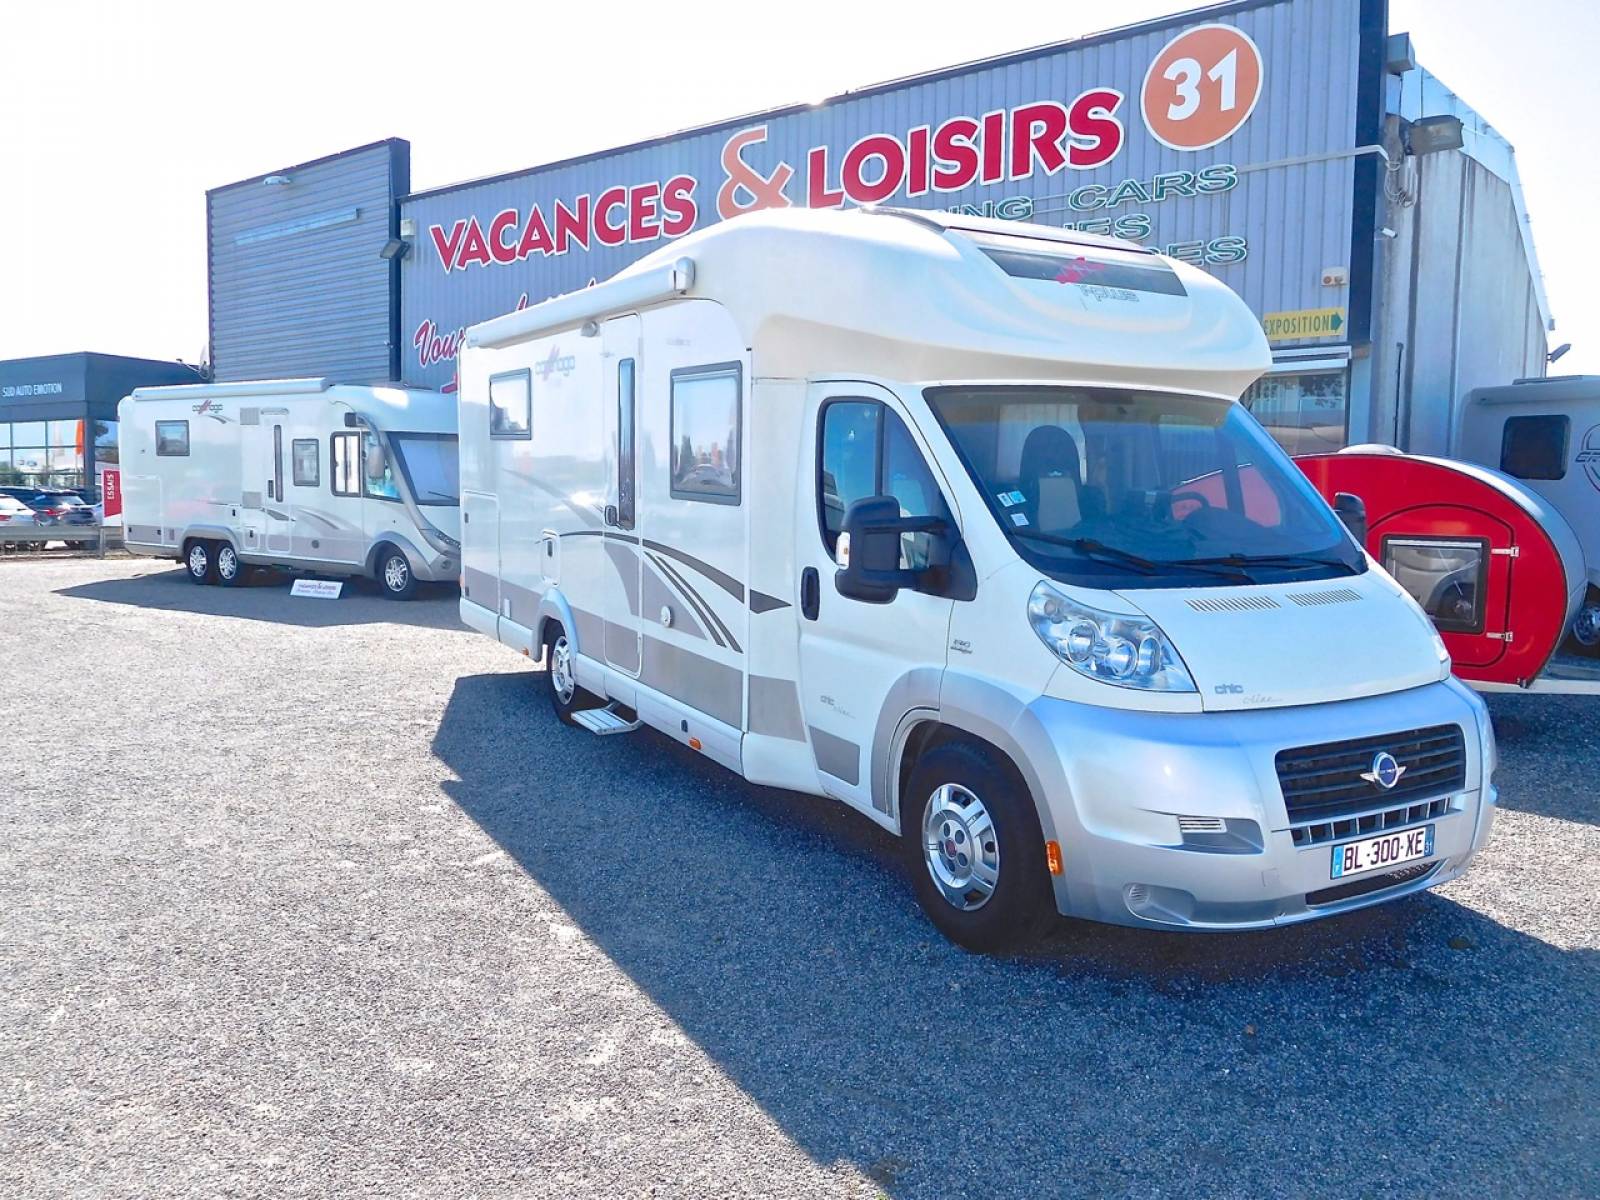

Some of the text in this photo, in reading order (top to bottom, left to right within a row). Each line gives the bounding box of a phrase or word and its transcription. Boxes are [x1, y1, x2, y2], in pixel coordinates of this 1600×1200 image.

[431, 48, 1237, 272] VACANCES & LOISIRS 31
[1068, 164, 1239, 210] CARS
[1264, 314, 1330, 336] EXPOSITION
